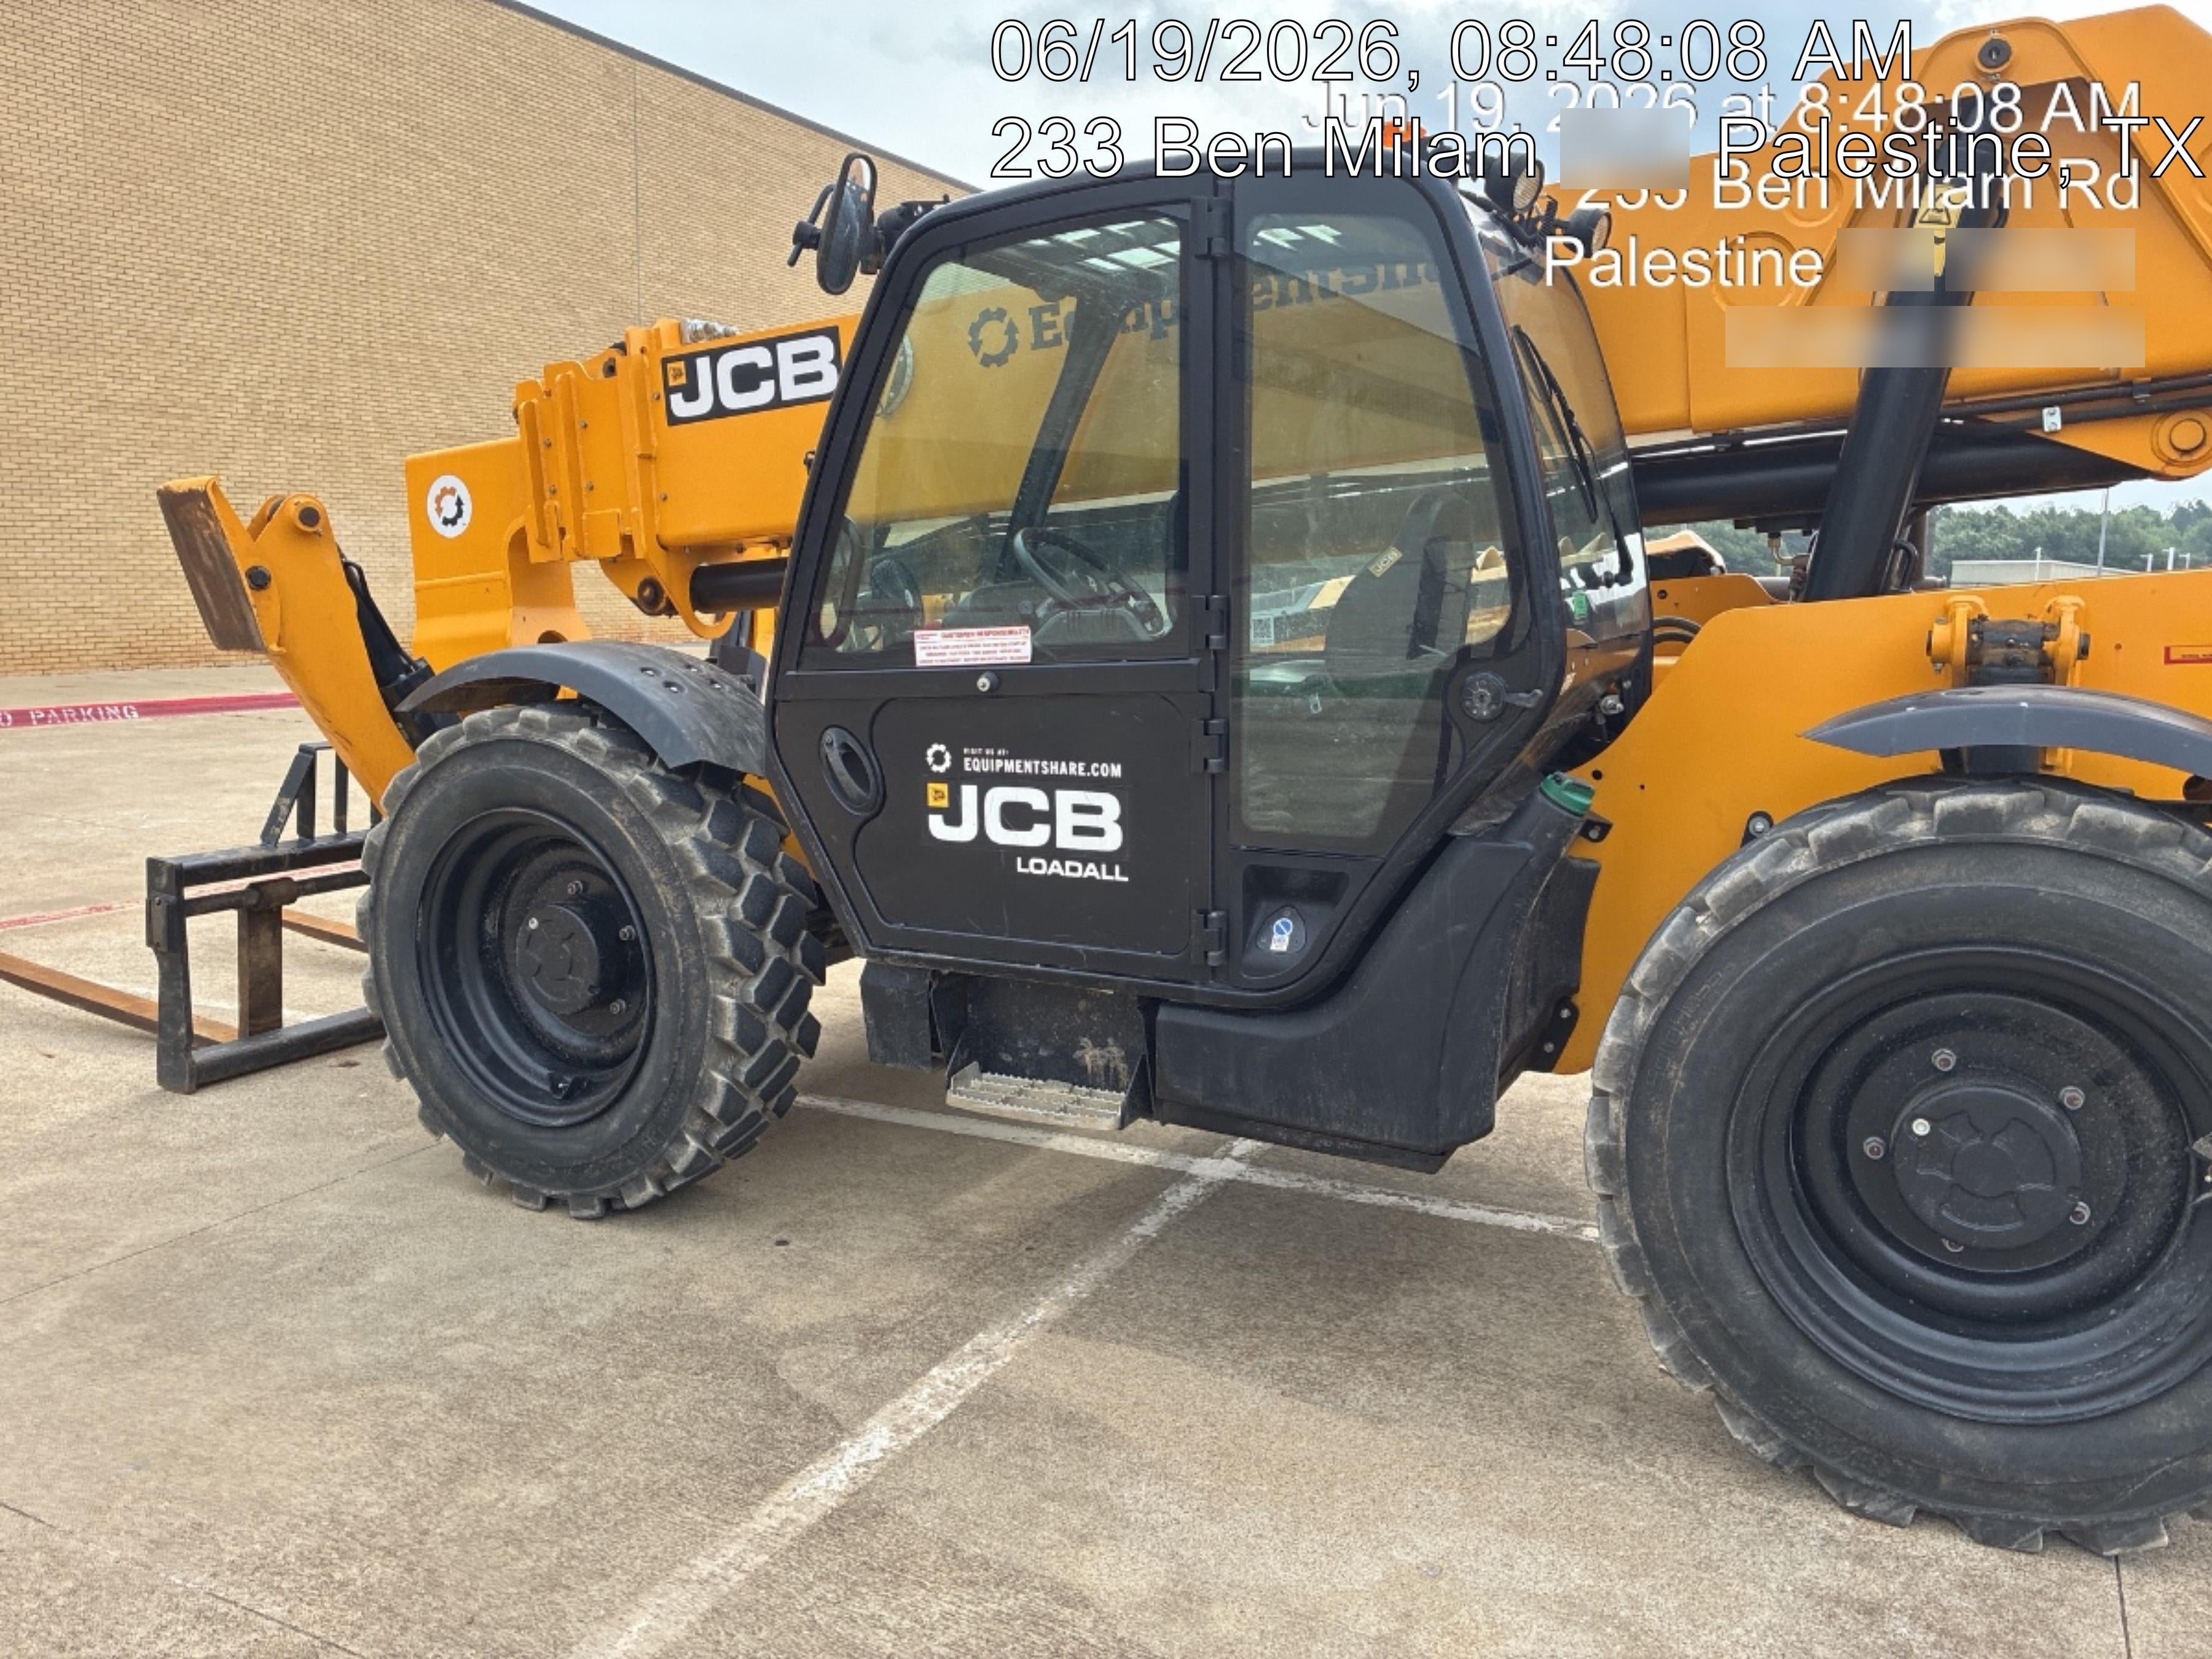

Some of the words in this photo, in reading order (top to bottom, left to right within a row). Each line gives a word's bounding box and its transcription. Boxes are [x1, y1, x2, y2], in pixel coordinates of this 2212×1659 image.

[669, 335, 840, 418] JCB
[29, 705, 139, 725] PARKING
[963, 757, 1122, 778] EQUIPMENTSHARE.COM
[928, 784, 1124, 852] JCB
[1017, 857, 1129, 882] LOADALL
